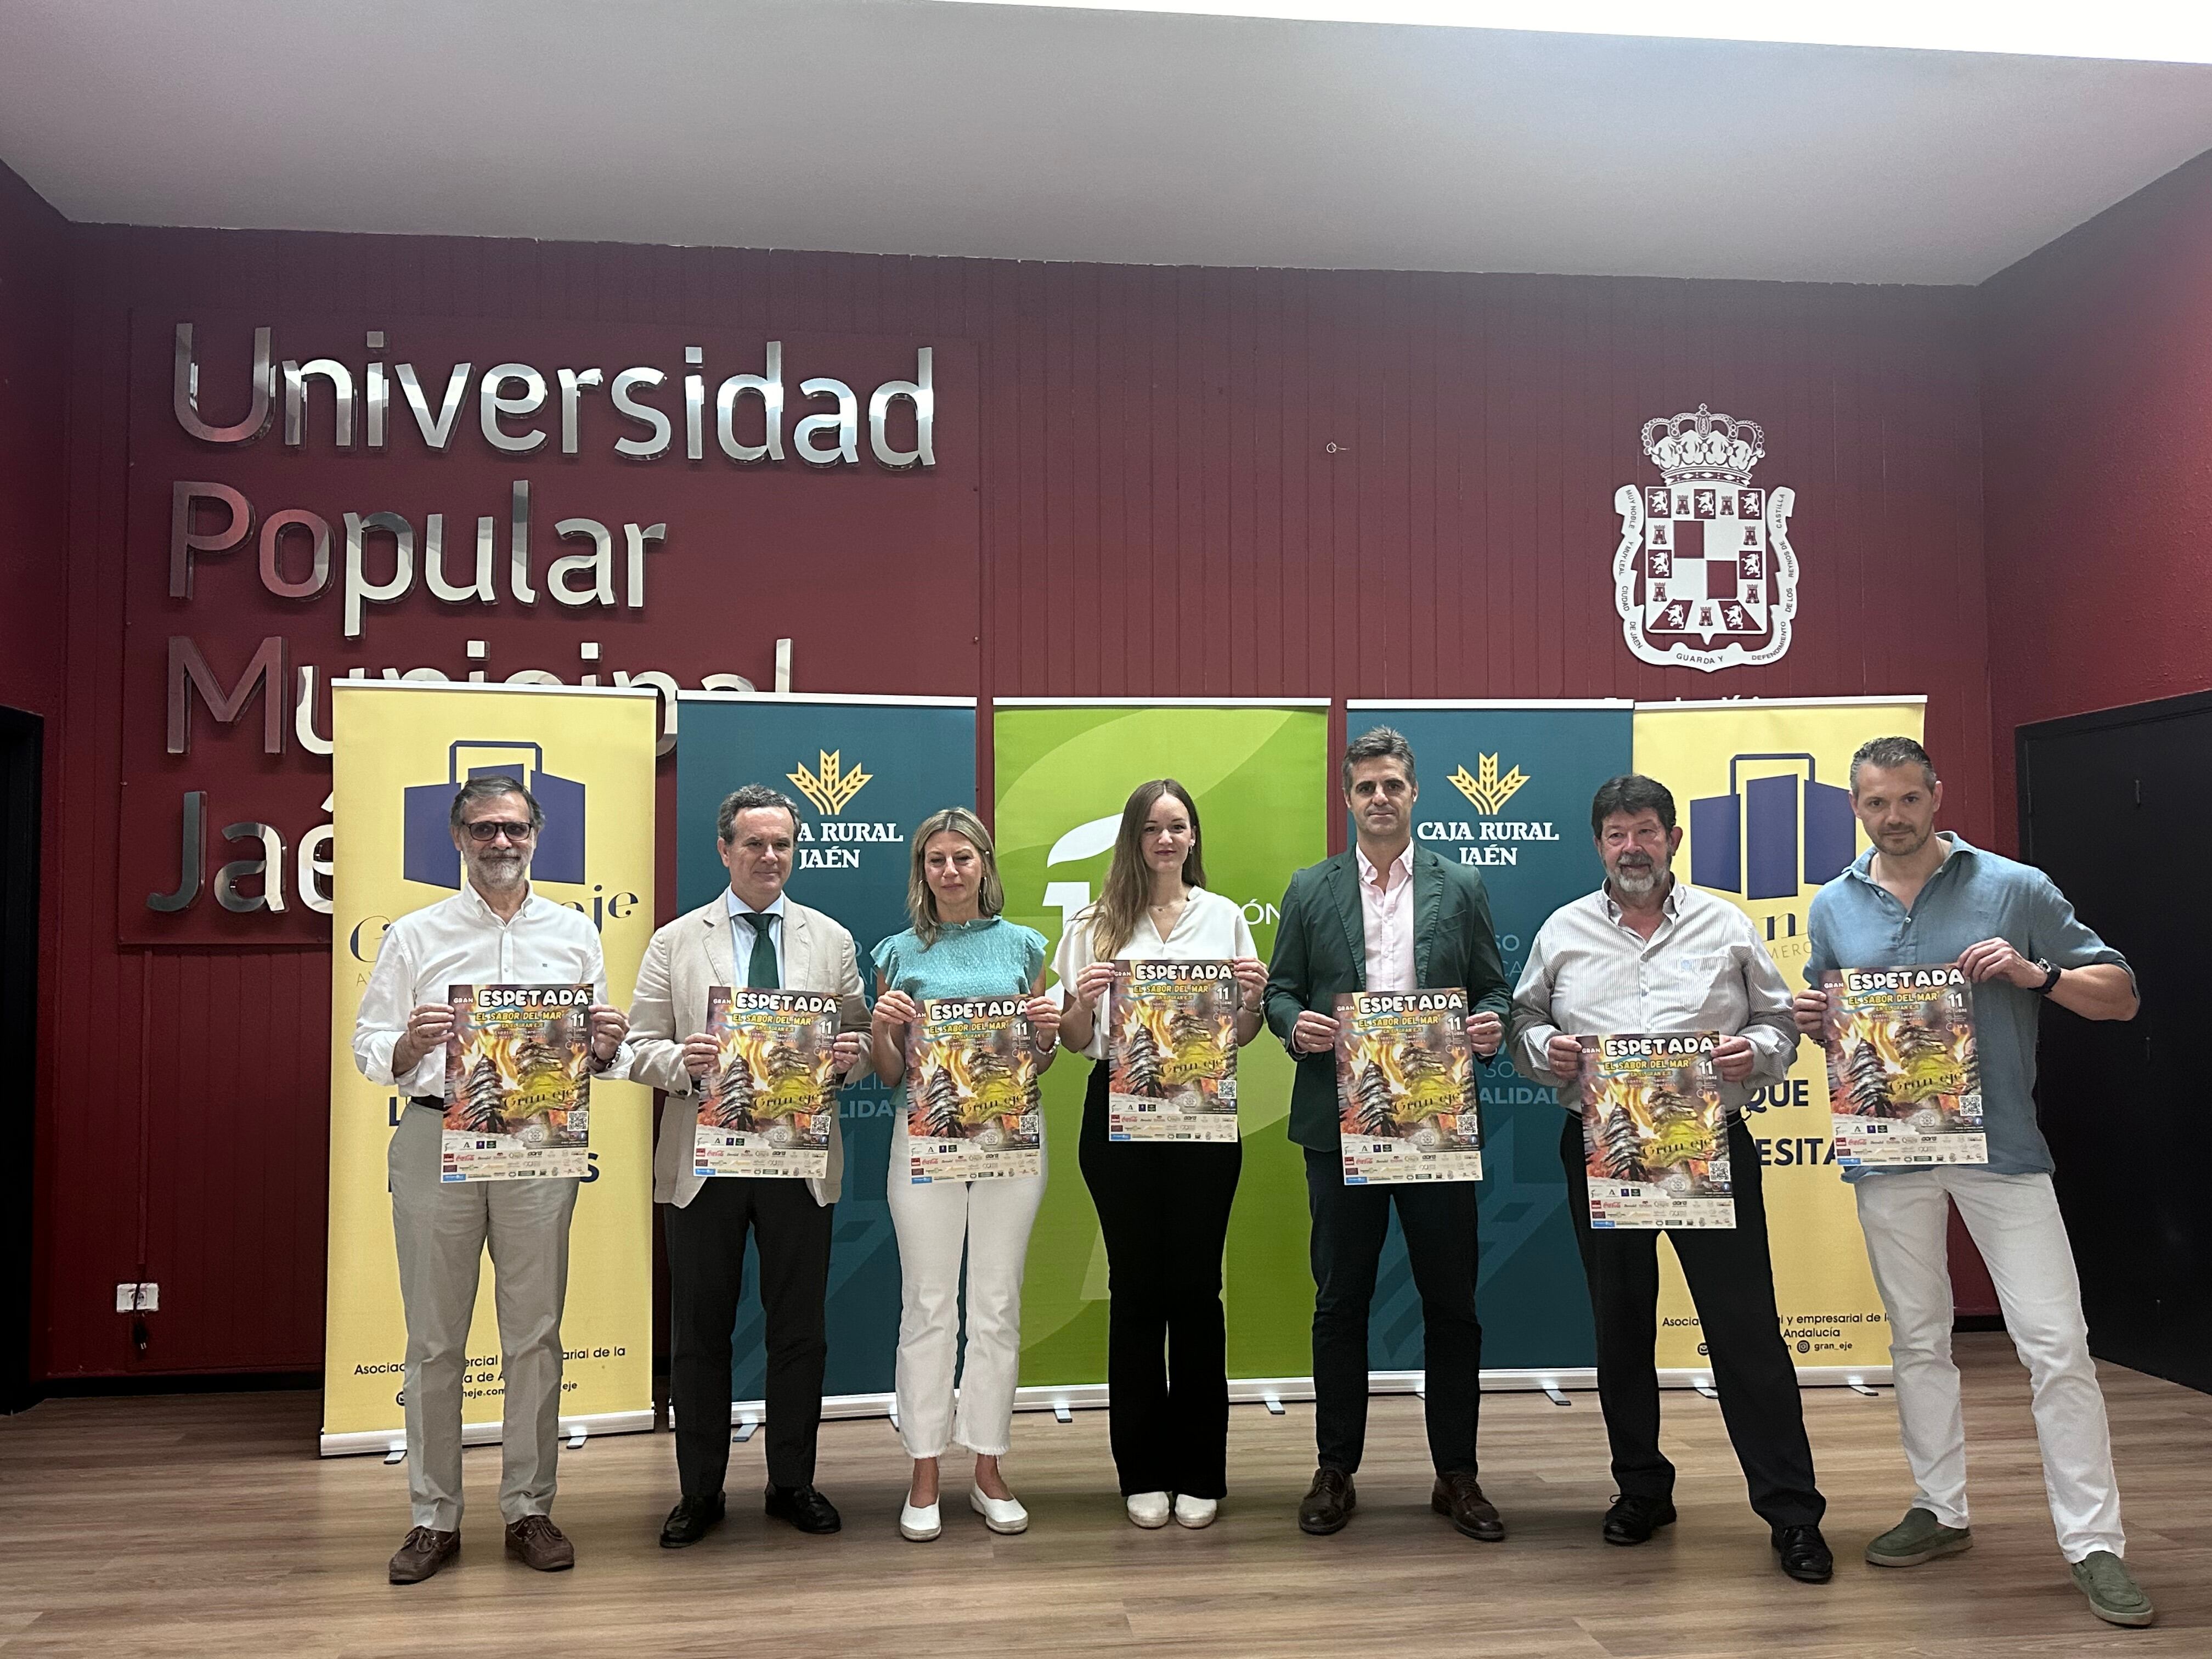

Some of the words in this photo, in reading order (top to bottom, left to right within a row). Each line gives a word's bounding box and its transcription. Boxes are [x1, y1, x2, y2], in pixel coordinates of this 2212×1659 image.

[173, 323, 936, 470] Universidad
[1626, 489, 1637, 505] MUY
[1776, 494, 1785, 529] CASTILLA
[168, 480, 667, 639] Popular
[1784, 550, 1794, 577] REYNOS
[1621, 585, 1630, 612] CIUDAD
[1629, 621, 1637, 631] DE
[1630, 631, 1643, 649] JAEN
[1751, 621, 1786, 661] DEFENDIMIENTO
[1676, 652, 1715, 664] GUARDA
[820, 822, 904, 843] RURAL
[1417, 821, 1475, 842] CAJA
[1479, 822, 1559, 842] RURAL
[799, 847, 860, 870] JAÉN
[1459, 844, 1518, 866] JAÉN
[1136, 964, 1232, 980] ESPETADA
[1849, 968, 1965, 991] ESPETADA
[479, 989, 589, 1007] ESPETADA
[1216, 987, 1228, 1000] 11
[1848, 996, 1860, 1005] EL
[1864, 995, 1893, 1004] SABOR
[1897, 993, 1914, 1002] DEL
[1917, 992, 1937, 1001] MAR
[1948, 992, 1962, 1008] 11
[736, 992, 837, 1014] ESPETADA
[931, 1000, 1028, 1020] ESPETADA
[1359, 994, 1463, 1014] ESPETADA
[476, 1013, 487, 1021] EL
[490, 1012, 520, 1020] SABOR
[523, 1012, 539, 1020] DEL
[542, 1011, 562, 1020] MAR
[571, 1013, 584, 1027] 11
[746, 1015, 772, 1023] SABOR
[776, 1016, 791, 1025] DEL
[794, 1017, 811, 1025] MAR
[1372, 1018, 1398, 1026] SABOR
[1402, 1017, 1417, 1025] DEL
[1447, 1017, 1461, 1030] 11
[820, 1020, 832, 1034] 11
[943, 1024, 968, 1033] SABOR
[972, 1023, 986, 1031] DEL
[989, 1022, 1007, 1030] MAR
[1015, 1022, 1027, 1036] 11
[1605, 1037, 1714, 1057] ESPETADA
[1161, 1062, 1197, 1073] Gran
[1204, 1059, 1223, 1069] eje
[1604, 1062, 1615, 1070] EL
[1619, 1060, 1646, 1069] SABOR
[1650, 1060, 1666, 1068] DEL
[1670, 1059, 1689, 1068] MAR
[1699, 1060, 1713, 1075] 11
[1889, 1078, 1932, 1090] Gran
[1940, 1072, 1963, 1085] eje
[504, 1093, 545, 1107] Gran
[552, 1088, 574, 1101] eje
[754, 1096, 792, 1108] Gran
[799, 1093, 819, 1105] eje
[961, 1101, 998, 1113] Gran
[1005, 1094, 1024, 1107] eje
[1394, 1099, 1433, 1111] Gran
[1440, 1093, 1460, 1105] eje
[1750, 1080, 1809, 1113] QUE
[1643, 1143, 1683, 1155] Gran
[1691, 1138, 1712, 1149] eje
[1663, 1317, 1700, 1327] Asocia
[1787, 1316, 1793, 1325] y
[1797, 1313, 1863, 1325] empresarial
[1866, 1313, 1881, 1323] de
[1783, 1327, 1840, 1338] Andalucía
[593, 1347, 610, 1358] de
[613, 1346, 626, 1357] la
[1814, 1342, 1853, 1351] gran_eje
[477, 1372, 494, 1383] de
